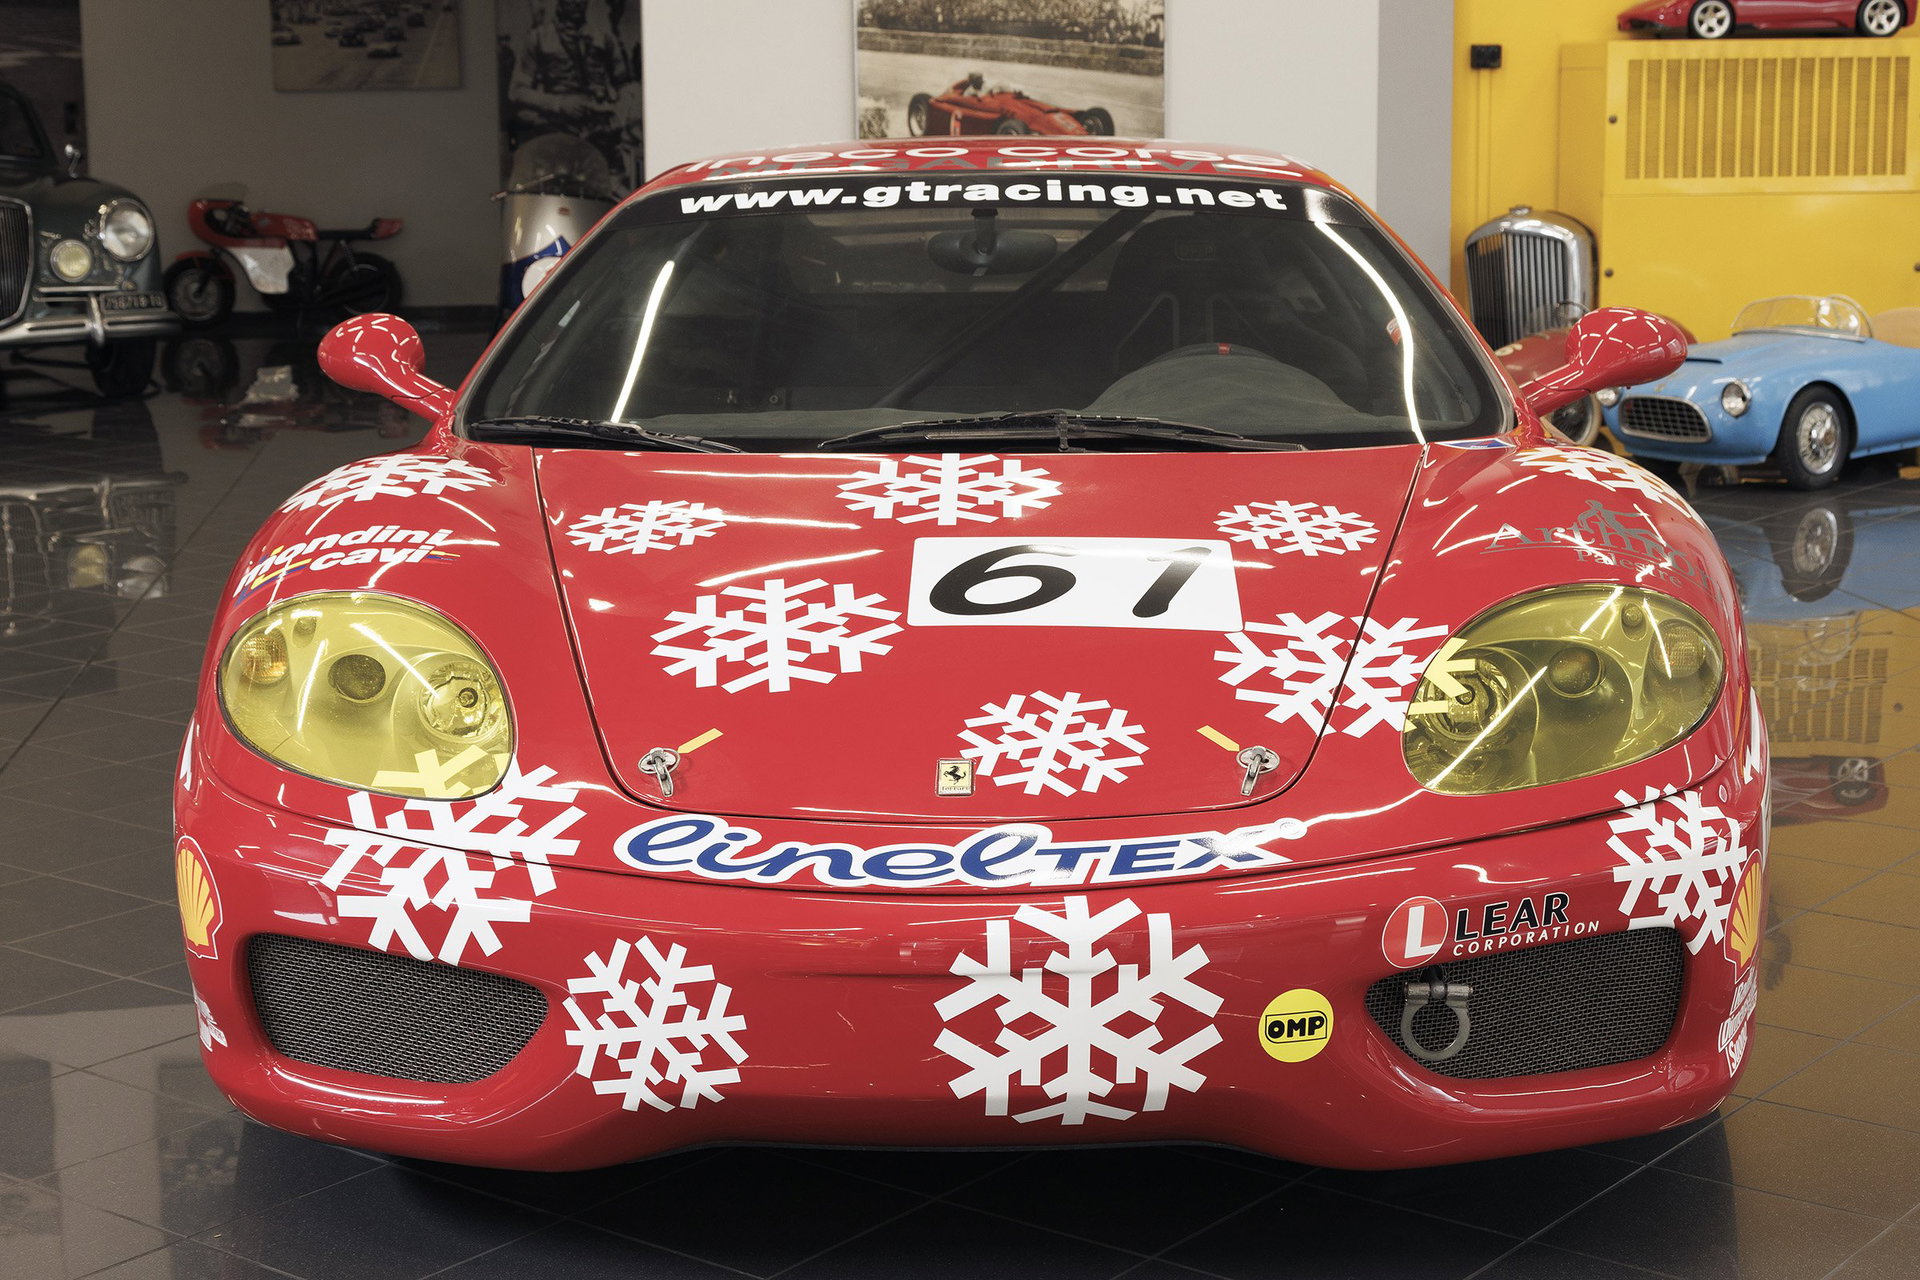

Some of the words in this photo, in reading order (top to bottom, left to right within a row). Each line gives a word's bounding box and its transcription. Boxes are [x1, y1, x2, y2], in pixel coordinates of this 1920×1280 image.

[997, 146, 1290, 167] corse
[680, 179, 1288, 215] www.gtracing.net
[309, 545, 436, 572] cavi
[928, 543, 1213, 619] 61
[1403, 904, 1443, 959] L
[1453, 891, 1570, 943] LEAR
[1452, 919, 1600, 957] CORPORATION
[1267, 1015, 1325, 1039] OMP
